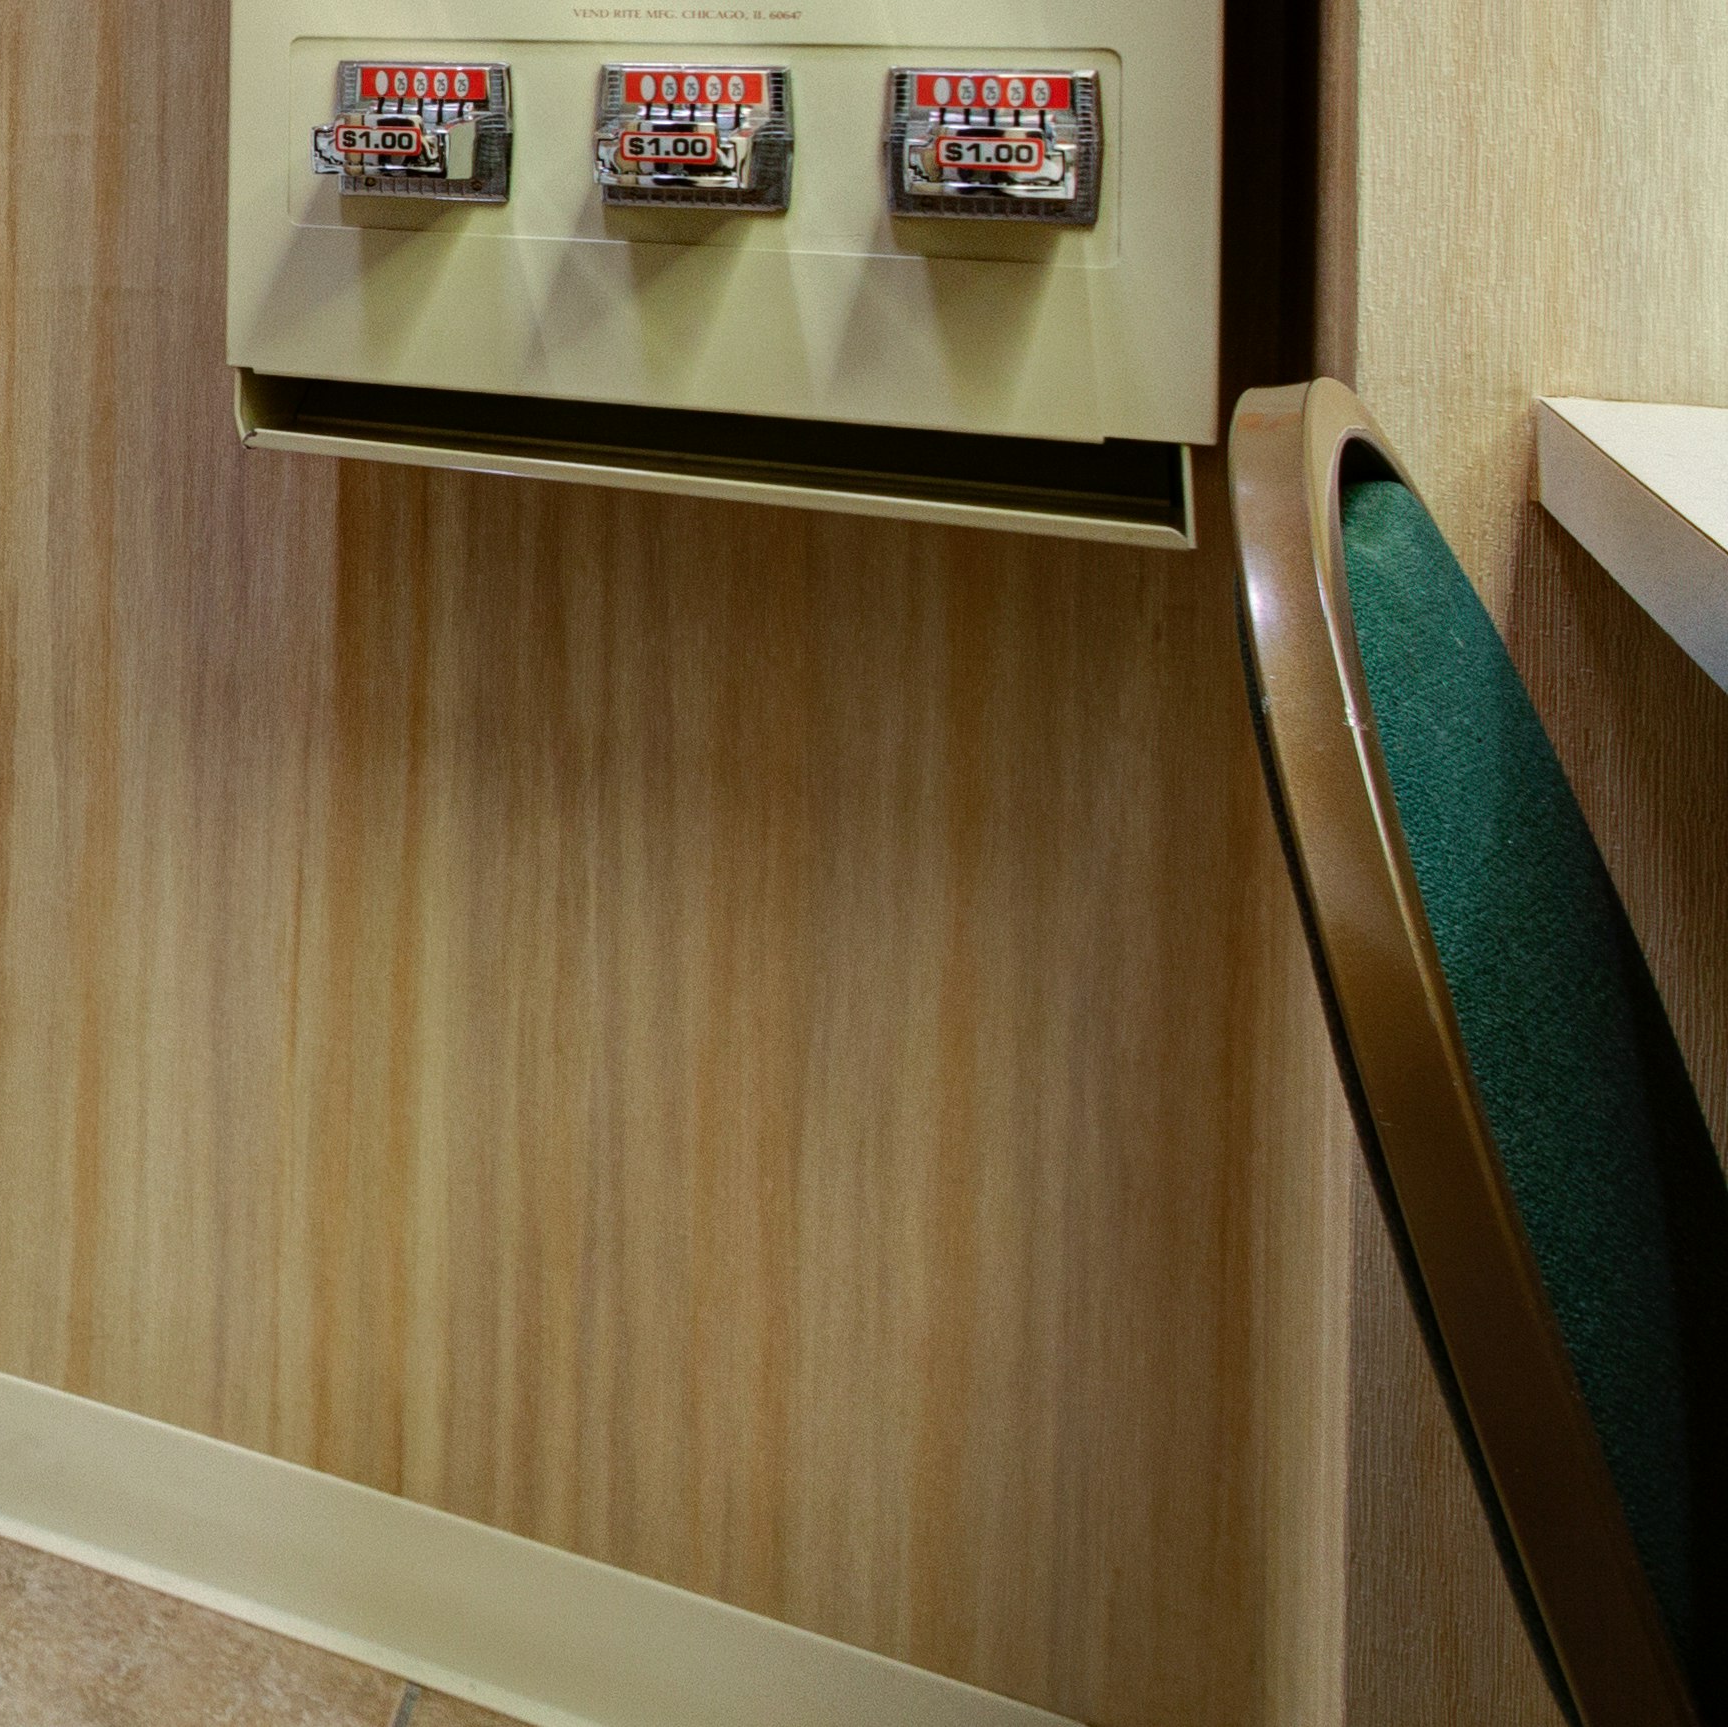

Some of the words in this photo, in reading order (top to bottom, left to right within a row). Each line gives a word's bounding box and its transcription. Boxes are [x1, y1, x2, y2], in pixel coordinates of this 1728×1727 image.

[573, 8, 609, 19] VEND
[613, 9, 641, 19] RITE
[342, 130, 413, 149] $1.00
[629, 137, 708, 157] $1.00
[945, 142, 1033, 163] $1.00
